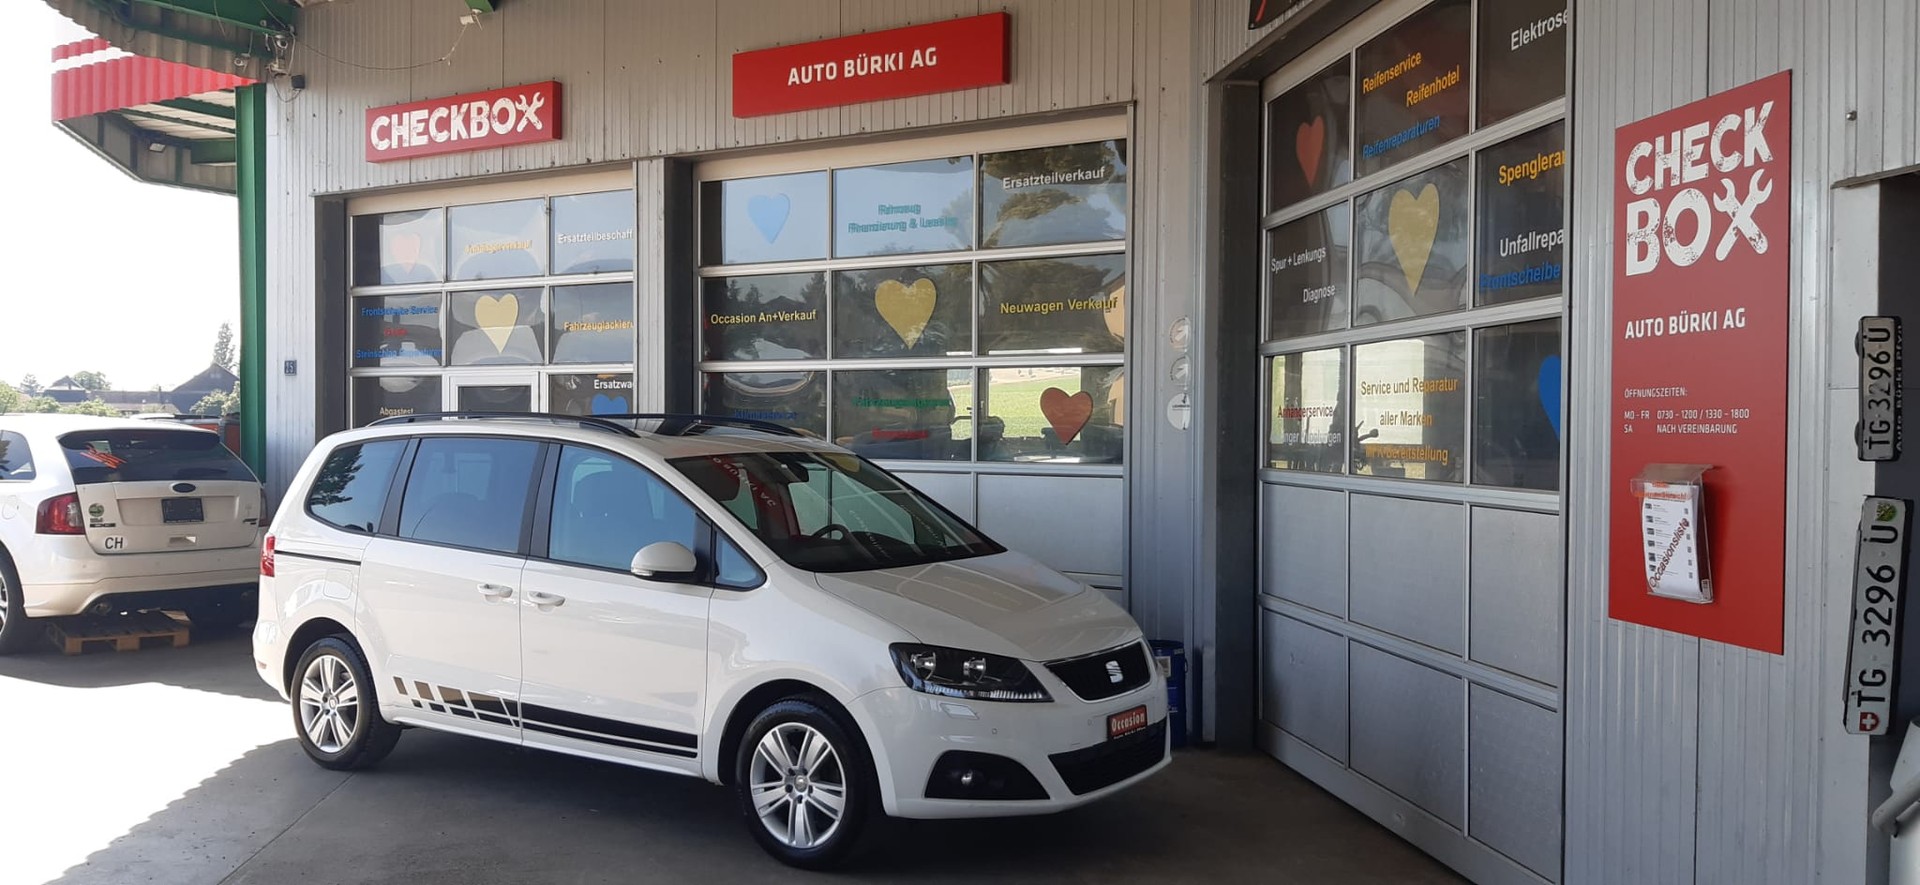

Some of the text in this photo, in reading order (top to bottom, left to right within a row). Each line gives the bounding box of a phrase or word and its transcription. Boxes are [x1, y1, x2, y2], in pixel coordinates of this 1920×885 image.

[787, 47, 937, 86] AUTO BÜRKI AG
[1362, 52, 1422, 95] Reifenservice
[1406, 64, 1460, 107] Reifenhotel
[370, 91, 545, 151] CHECKBOX
[1362, 115, 1440, 160] Reifenreparaturen
[1625, 100, 1775, 195] CHECK
[1002, 166, 1105, 189] Ersatzteilverkauf
[1625, 168, 1774, 277] BOX
[1500, 229, 1565, 258] Unfallrepa
[1271, 258, 1287, 274] Spur
[1000, 296, 1118, 315] Neuwagen Verkauf
[1303, 285, 1336, 304] Diagnose
[710, 309, 817, 325] Occasion An+Verkauf
[1625, 307, 1745, 340] AUTO BÜRKI AG
[593, 379, 633, 390] Ersatzwa
[1360, 377, 1459, 396] Service und Reparatur
[1624, 386, 1688, 399] ÖFFNUNGSZEITEN:
[1867, 351, 1891, 411] 3296
[1380, 410, 1433, 426] aller Marken
[1624, 410, 1635, 420] MO
[1641, 410, 1650, 420] FR
[1656, 409, 1674, 420] 0730
[1681, 409, 1698, 419] 1200
[1705, 408, 1722, 419] 1330
[1731, 408, 1750, 419] 1800
[1624, 423, 1738, 434] SA NACH VEREINBARUNG
[1868, 420, 1891, 450] TG
[105, 536, 124, 550] CH
[1861, 564, 1896, 647] 3296
[1856, 668, 1887, 708] TG
[1111, 711, 1146, 733] Occasion
